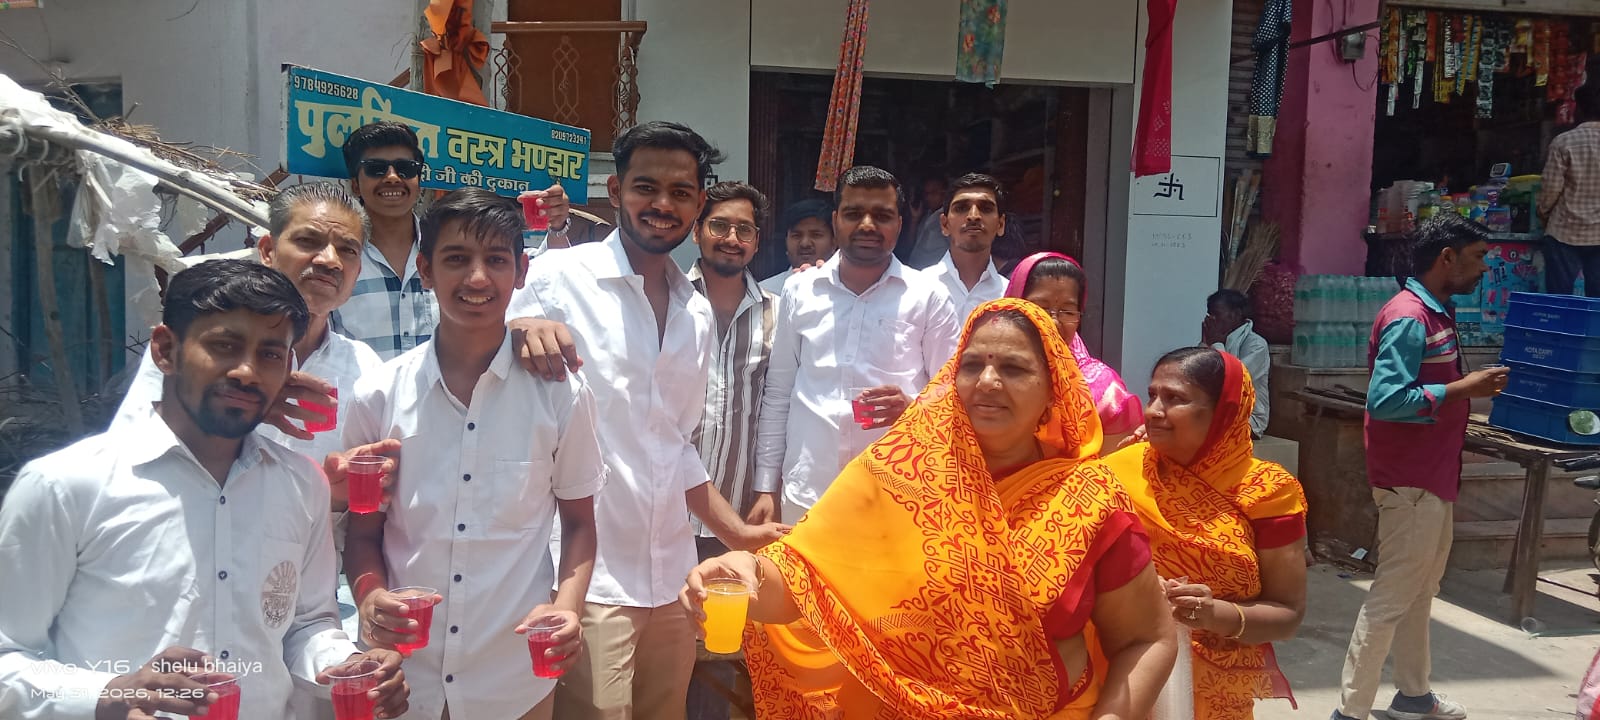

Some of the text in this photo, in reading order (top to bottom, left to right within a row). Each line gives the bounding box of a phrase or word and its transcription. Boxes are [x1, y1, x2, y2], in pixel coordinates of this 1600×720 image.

[294, 75, 359, 100] 9784925628
[447, 128, 507, 169] वस्त्र
[512, 139, 586, 180] भण्डार
[434, 165, 457, 183] जी
[459, 169, 484, 187] की
